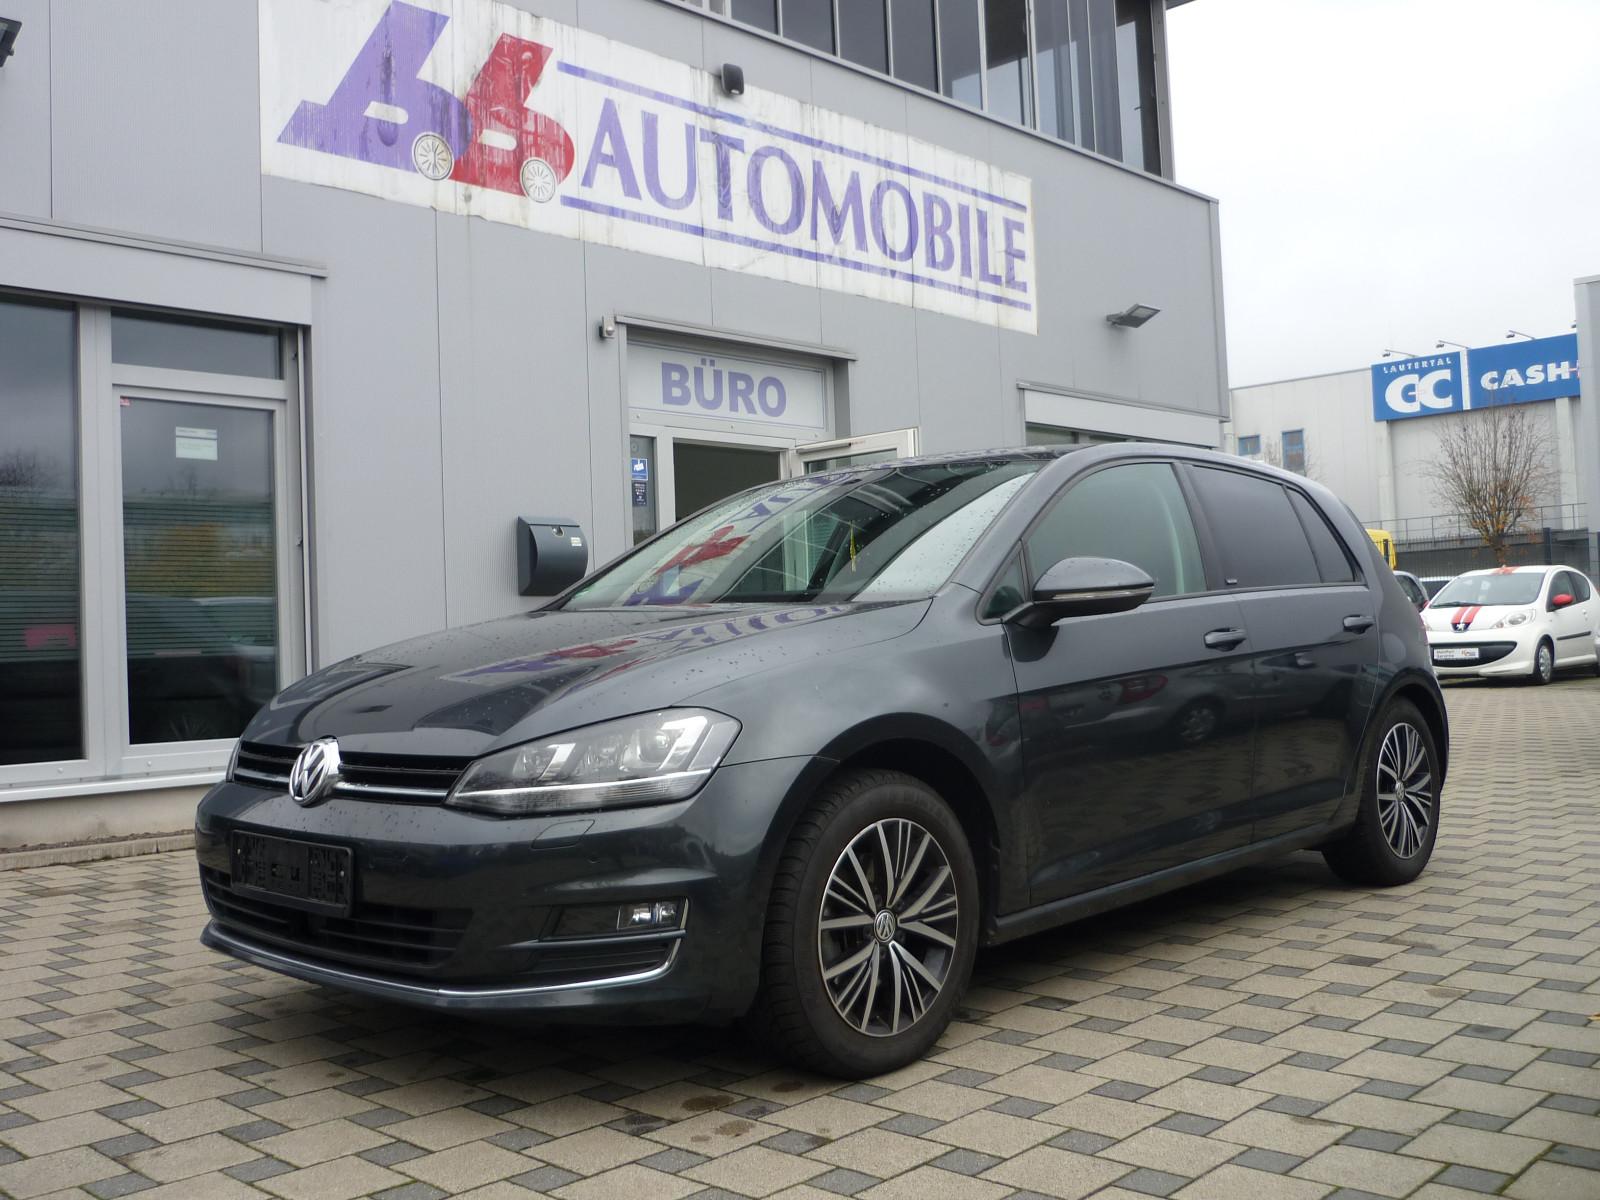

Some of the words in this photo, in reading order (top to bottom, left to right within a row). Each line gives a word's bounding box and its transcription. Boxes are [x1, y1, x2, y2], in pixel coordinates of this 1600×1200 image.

[581, 98, 1028, 294] AUTOMOBILE
[661, 358, 787, 418] BÜRO
[1383, 357, 1452, 374] LAUTERTAL
